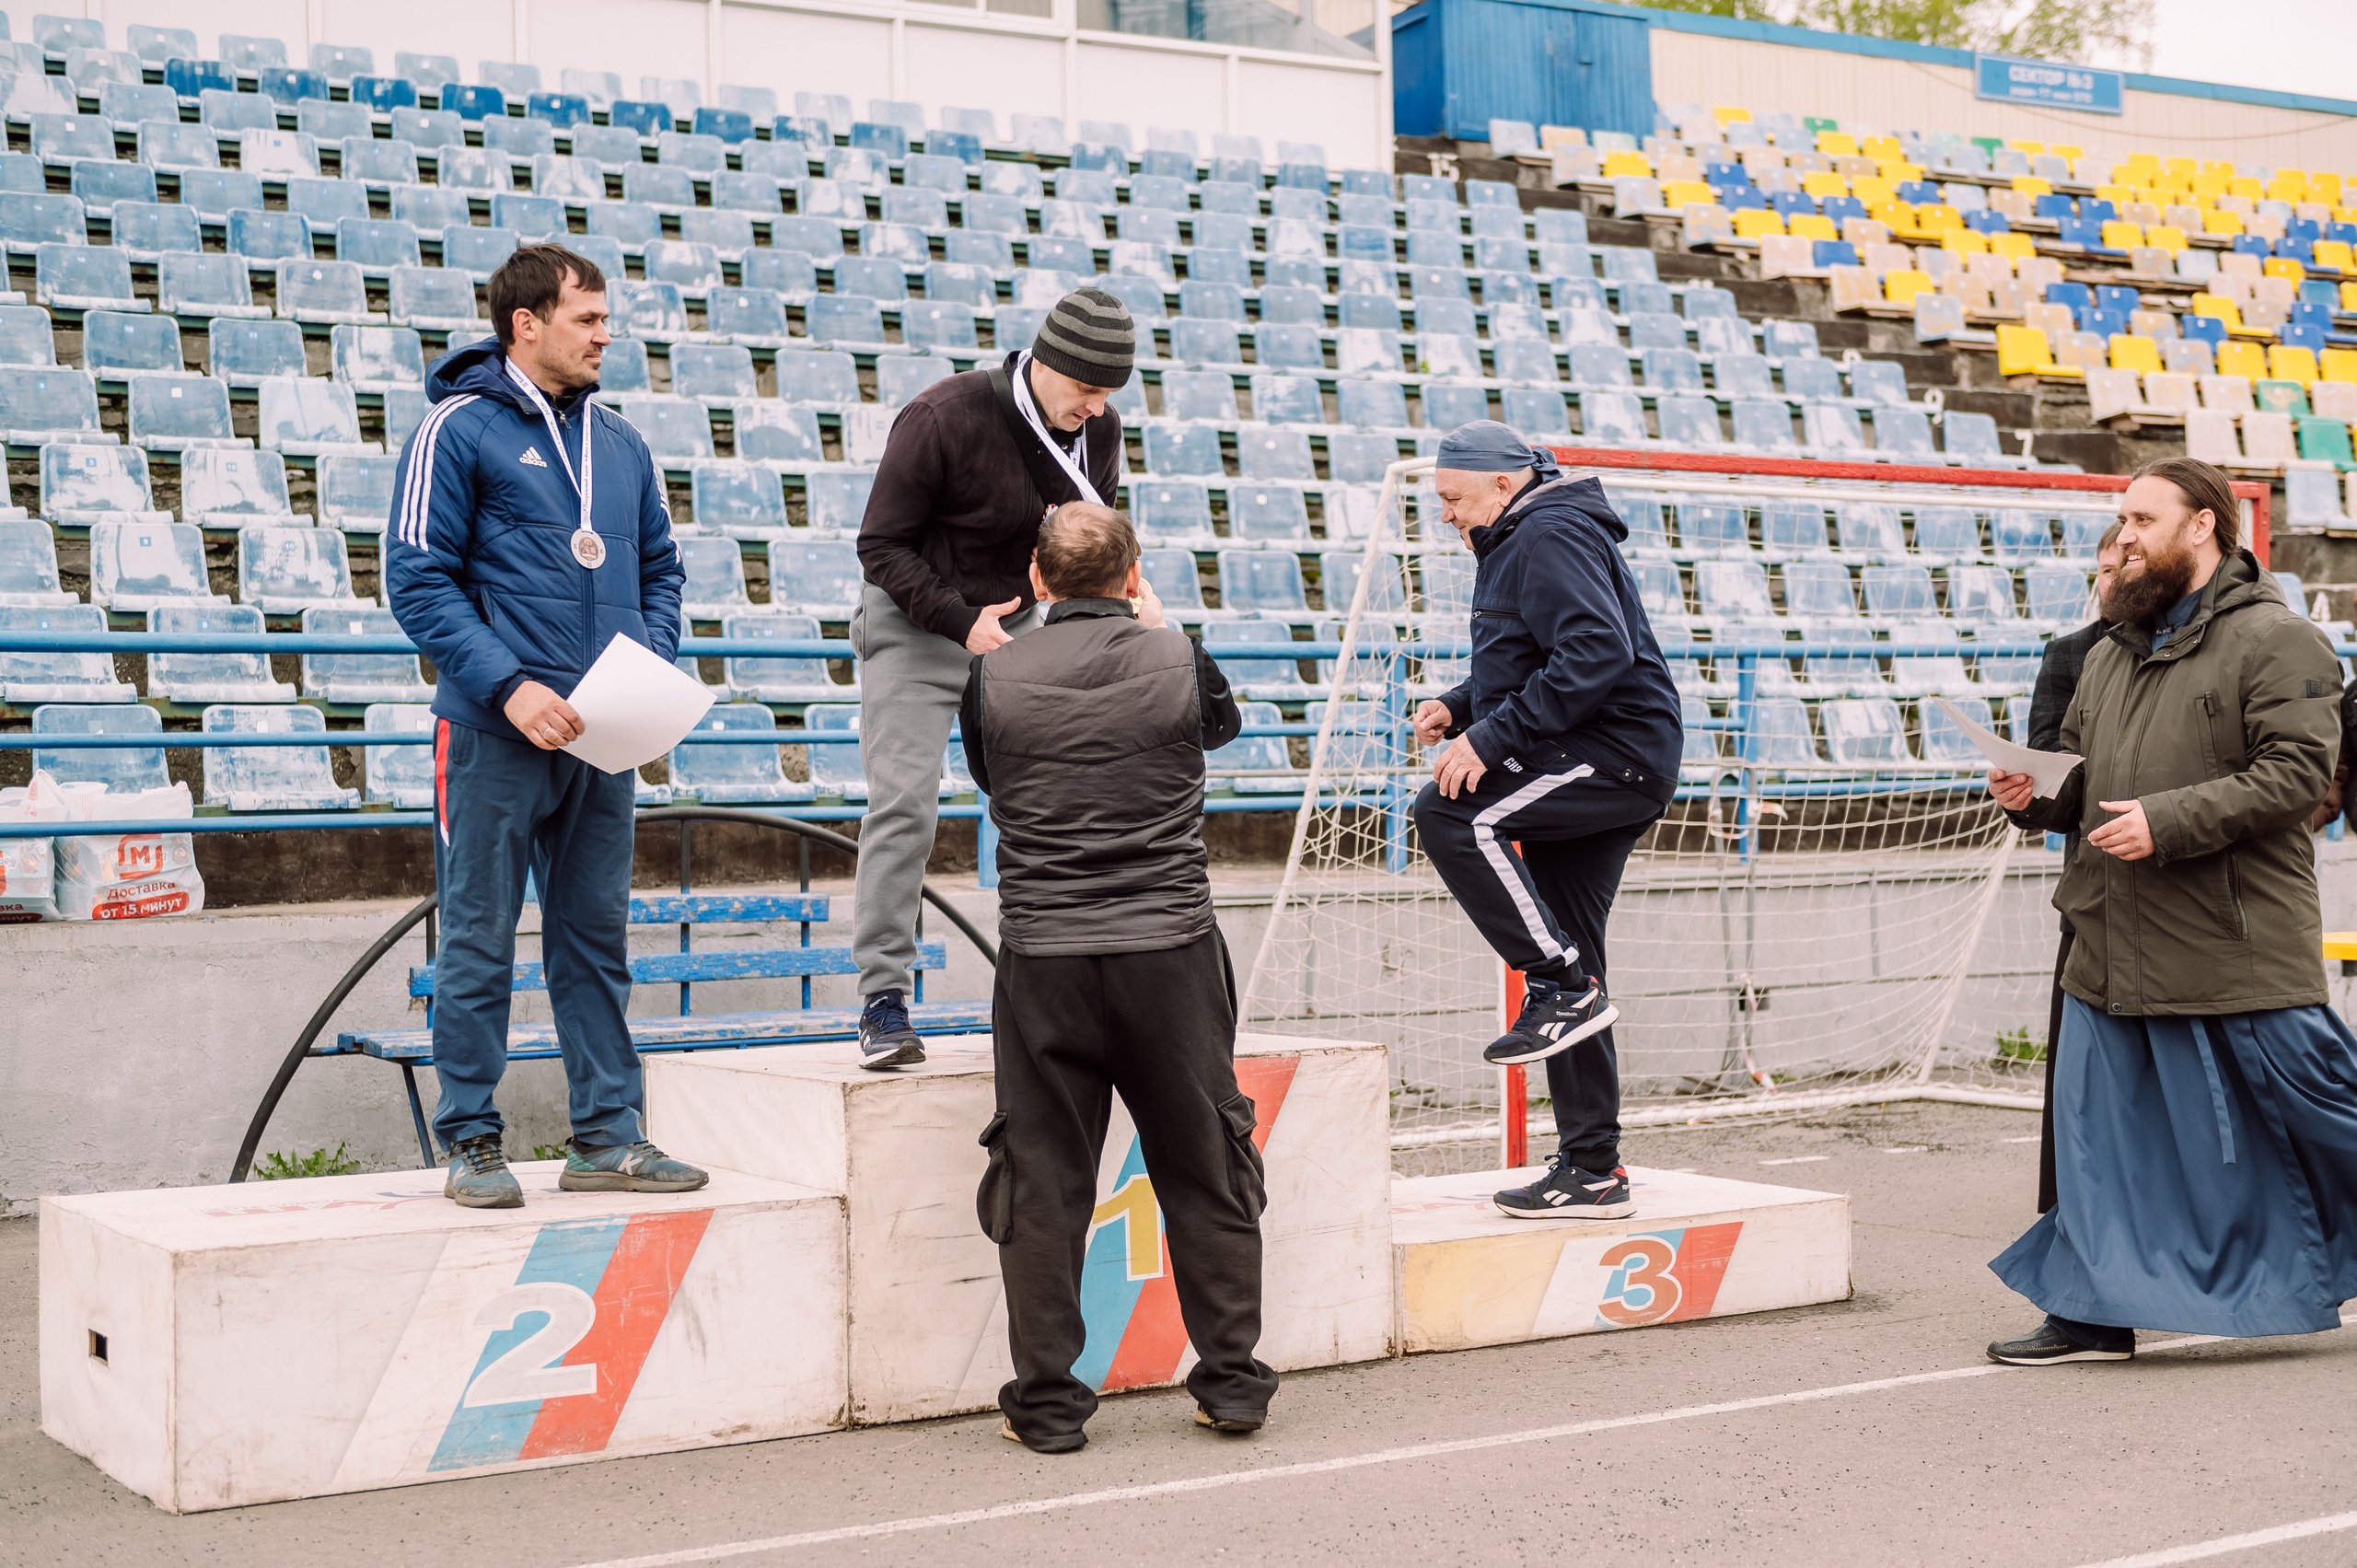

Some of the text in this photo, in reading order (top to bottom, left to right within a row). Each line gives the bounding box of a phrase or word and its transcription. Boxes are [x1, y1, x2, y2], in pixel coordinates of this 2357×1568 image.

[2008, 64, 2065, 87] СЕКТОР
[2014, 428, 2034, 458] 7
[519, 457, 548, 468] adidas
[107, 881, 176, 900] Доставка
[101, 907, 119, 919] от
[122, 903, 137, 916] 15
[140, 897, 182, 914] минут
[1091, 1173, 1164, 1282] 1
[1597, 1235, 1683, 1326] 3
[462, 1281, 598, 1409] 2
